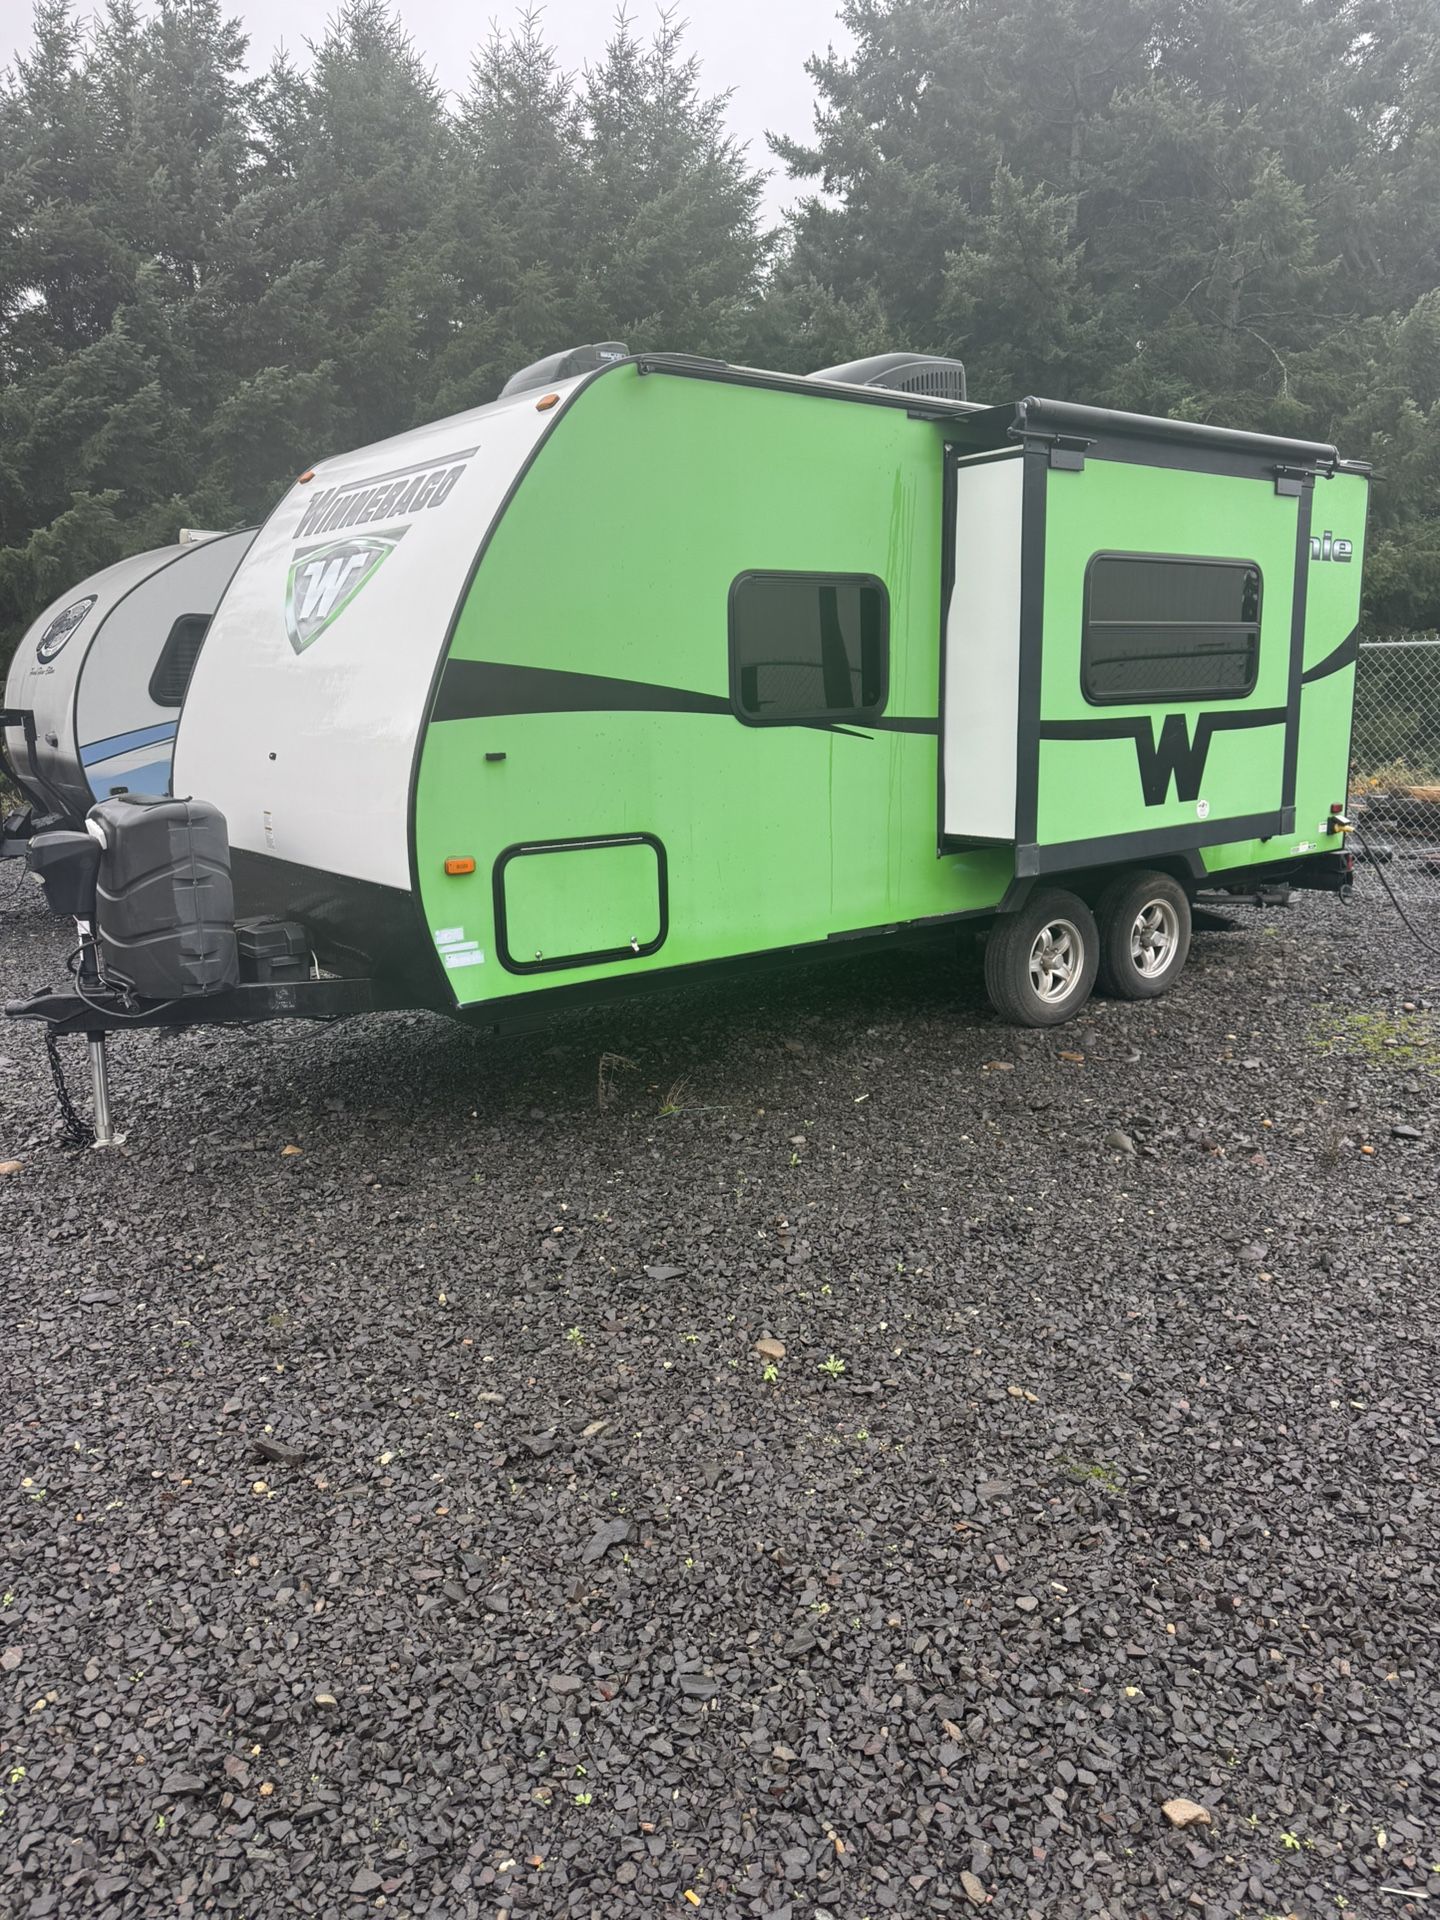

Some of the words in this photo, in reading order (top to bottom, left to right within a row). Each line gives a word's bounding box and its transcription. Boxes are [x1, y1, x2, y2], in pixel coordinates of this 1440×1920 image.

[292, 464, 467, 539] WINNEBAGO
[299, 552, 370, 619] W
[1134, 713, 1213, 807] W
